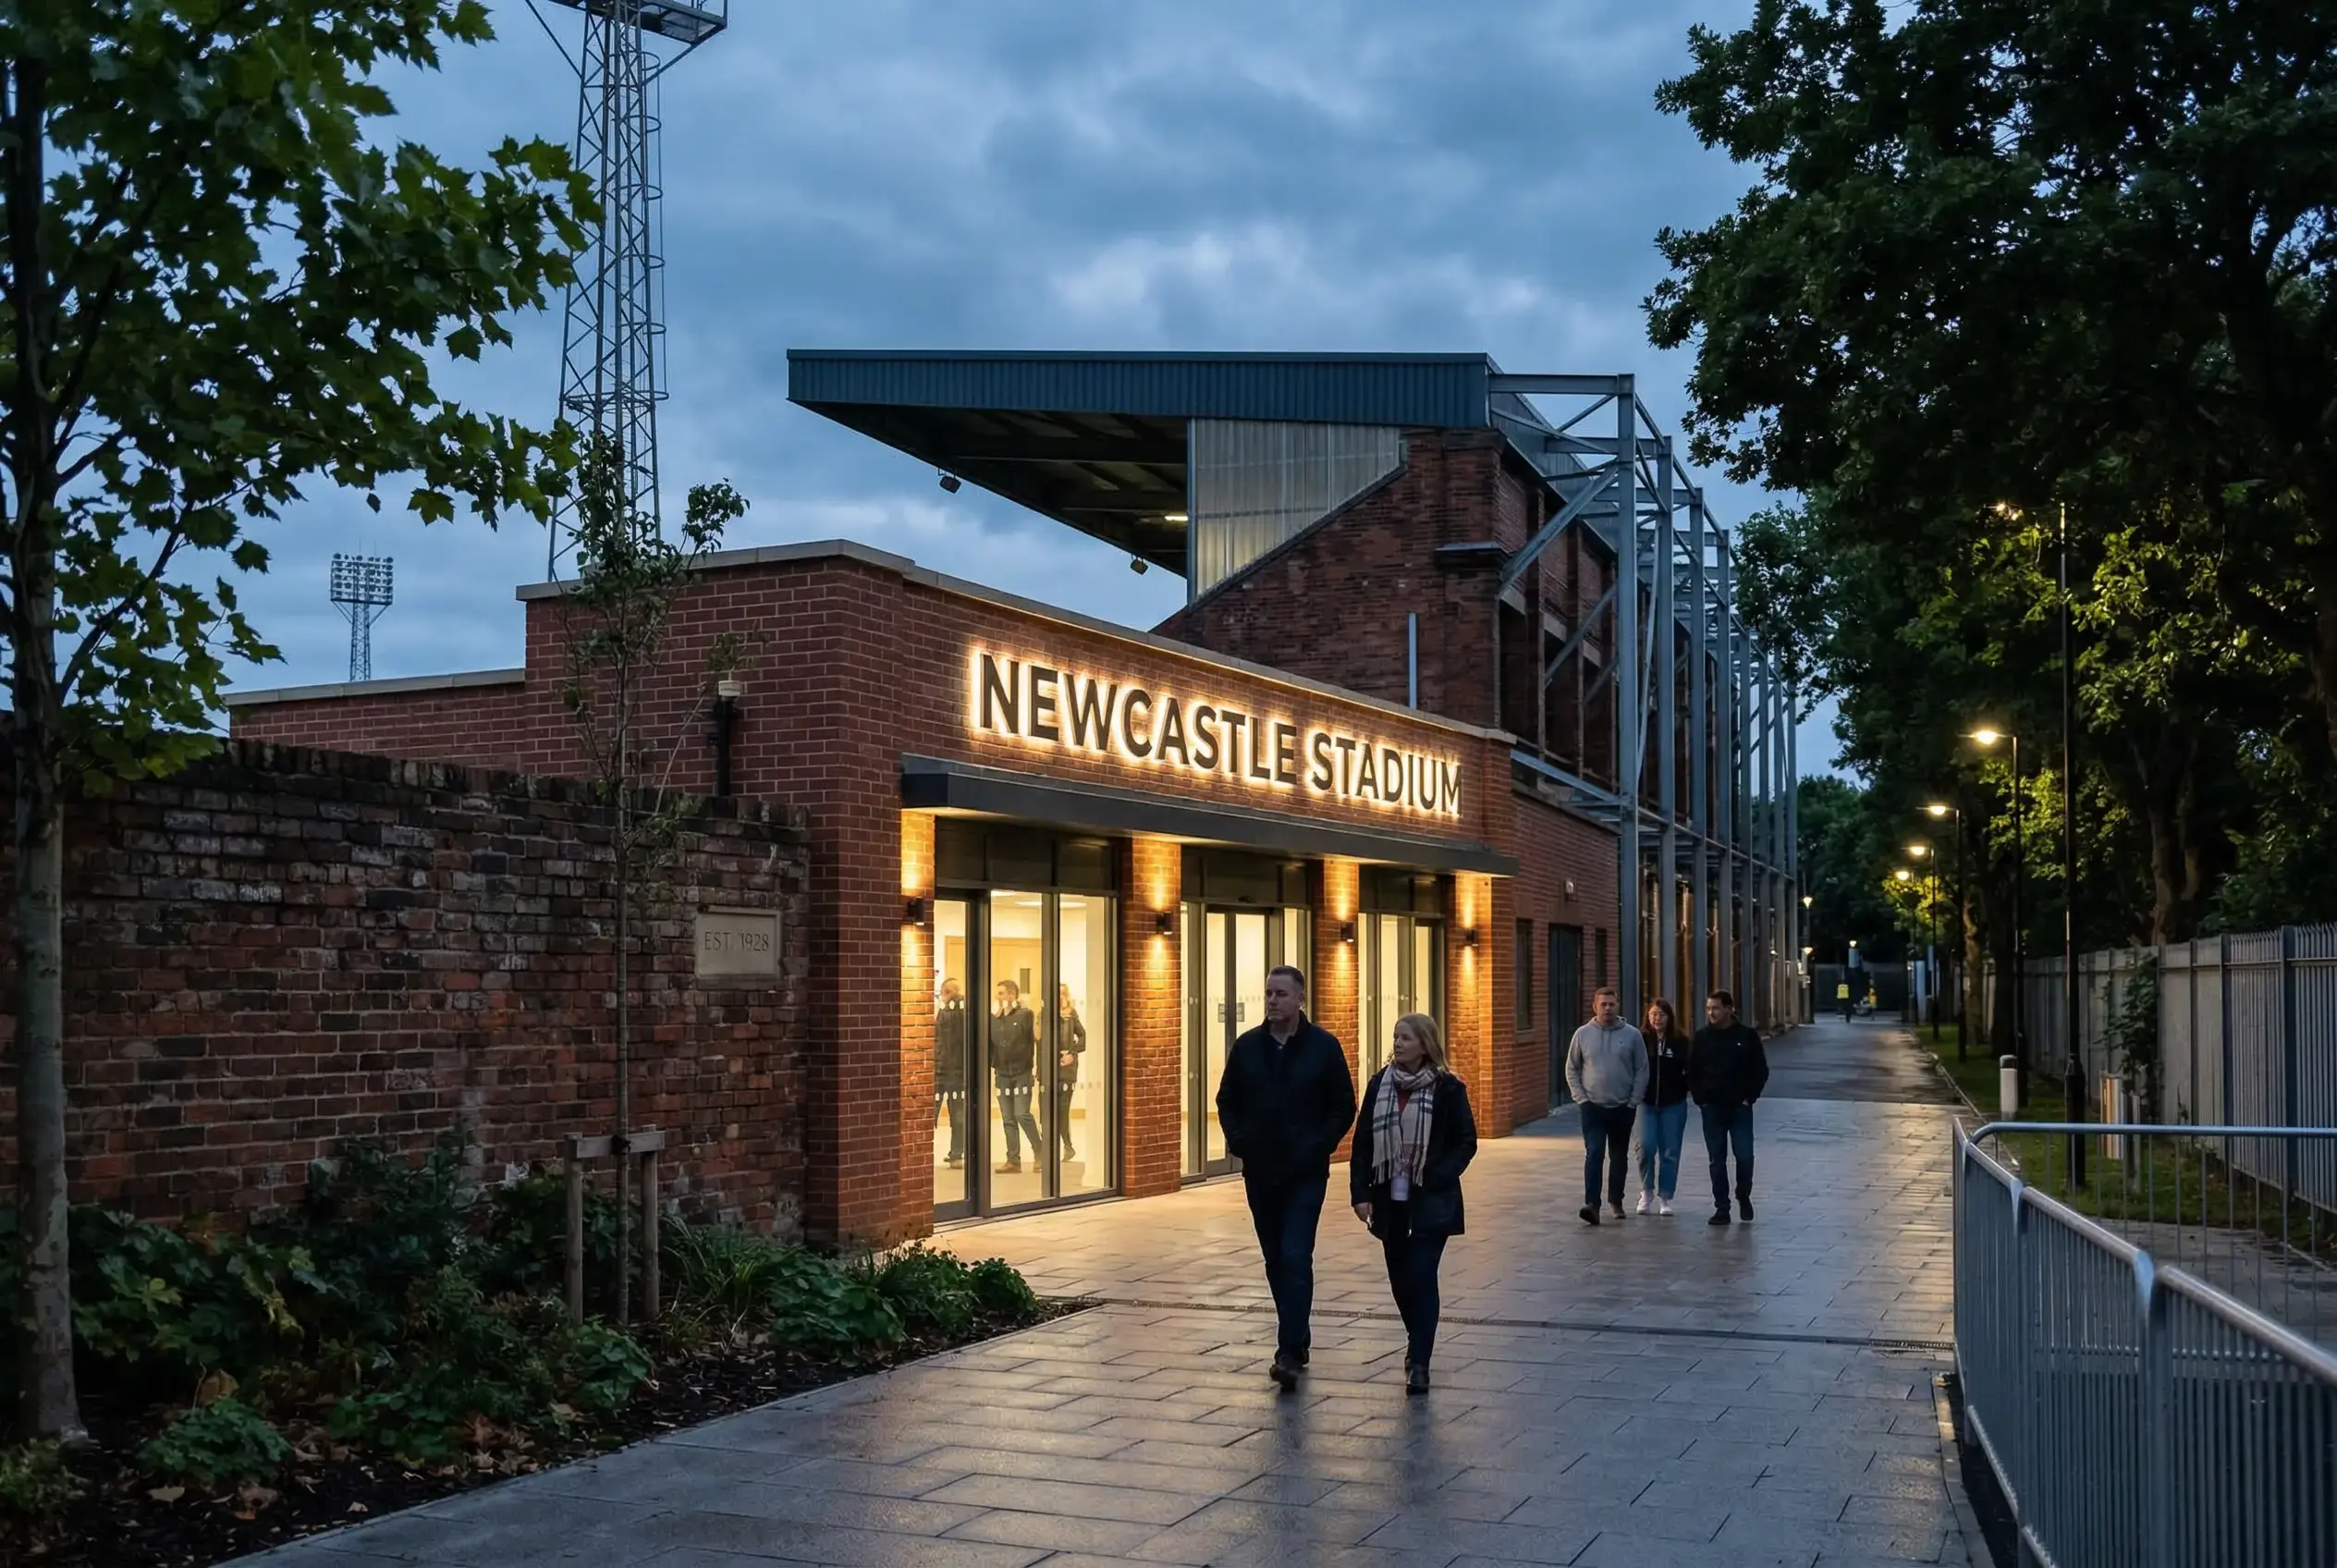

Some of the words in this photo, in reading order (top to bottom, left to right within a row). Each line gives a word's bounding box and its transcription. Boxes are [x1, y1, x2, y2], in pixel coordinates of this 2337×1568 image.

[980, 654, 1297, 784] NEWCASTLE
[1312, 731, 1462, 816] STADIUM
[738, 932, 770, 952] 1928
